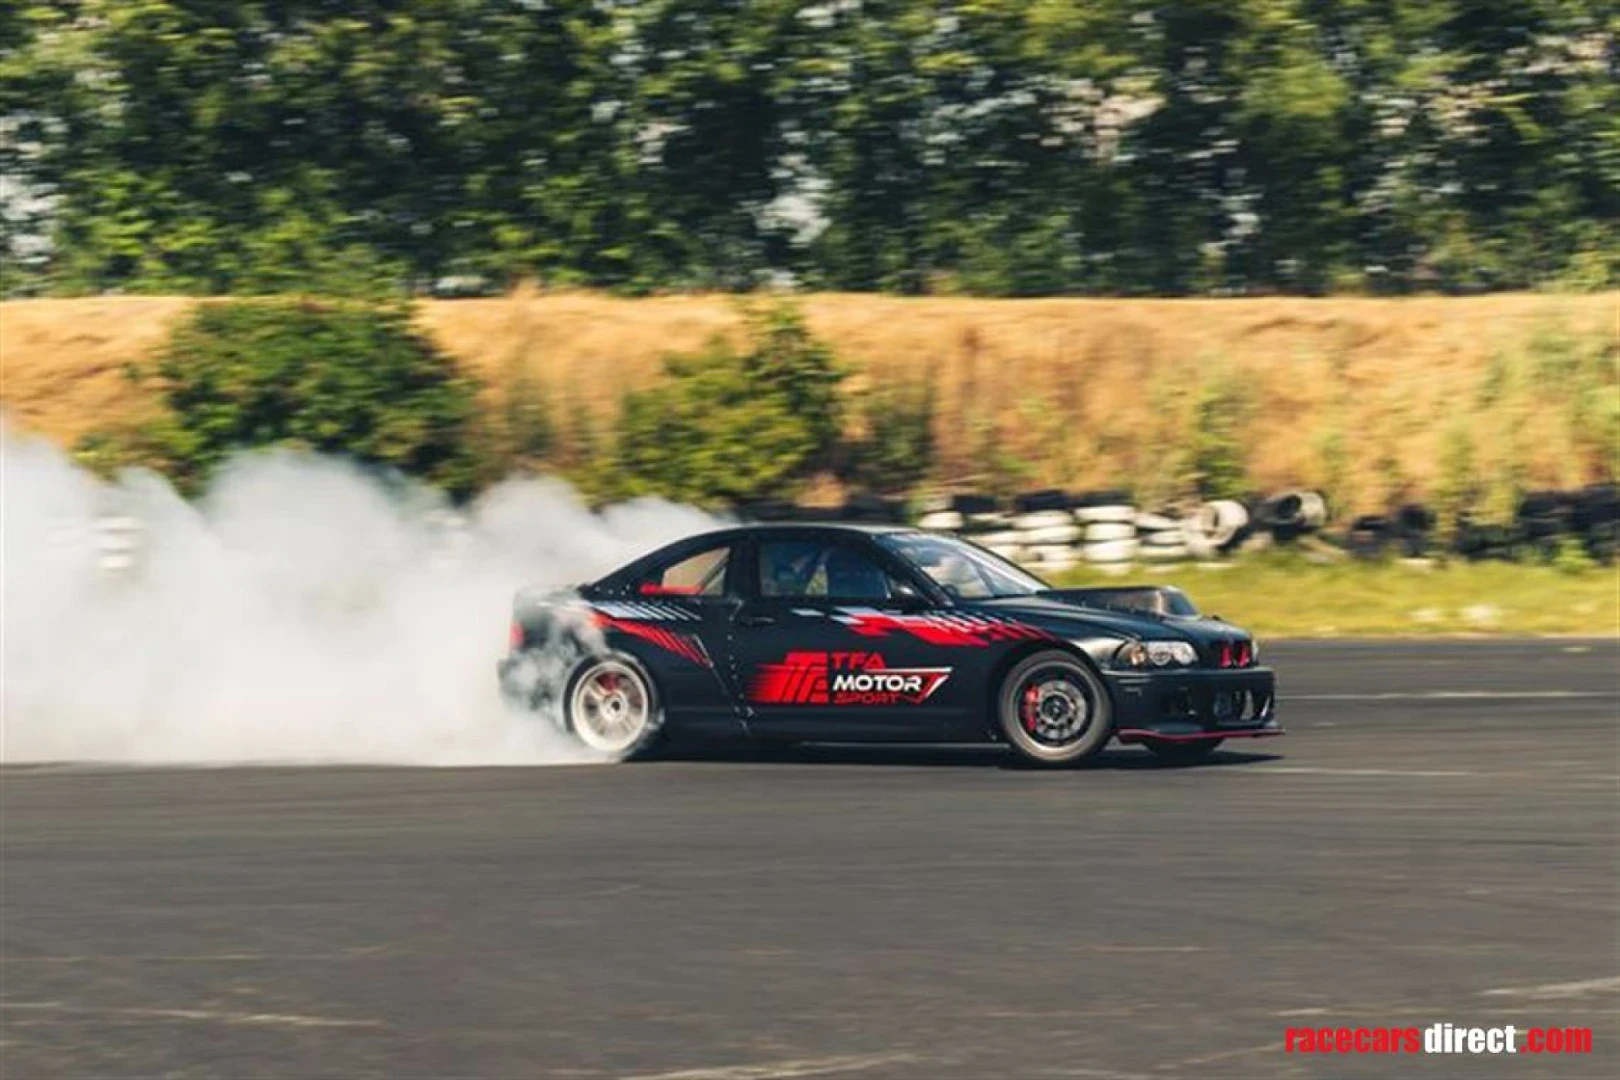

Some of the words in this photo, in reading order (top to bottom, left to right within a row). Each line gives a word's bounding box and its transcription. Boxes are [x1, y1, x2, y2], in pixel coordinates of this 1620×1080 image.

[831, 652, 886, 669] TFA
[833, 675, 922, 692] MOTOR
[834, 693, 899, 704] SPORT
